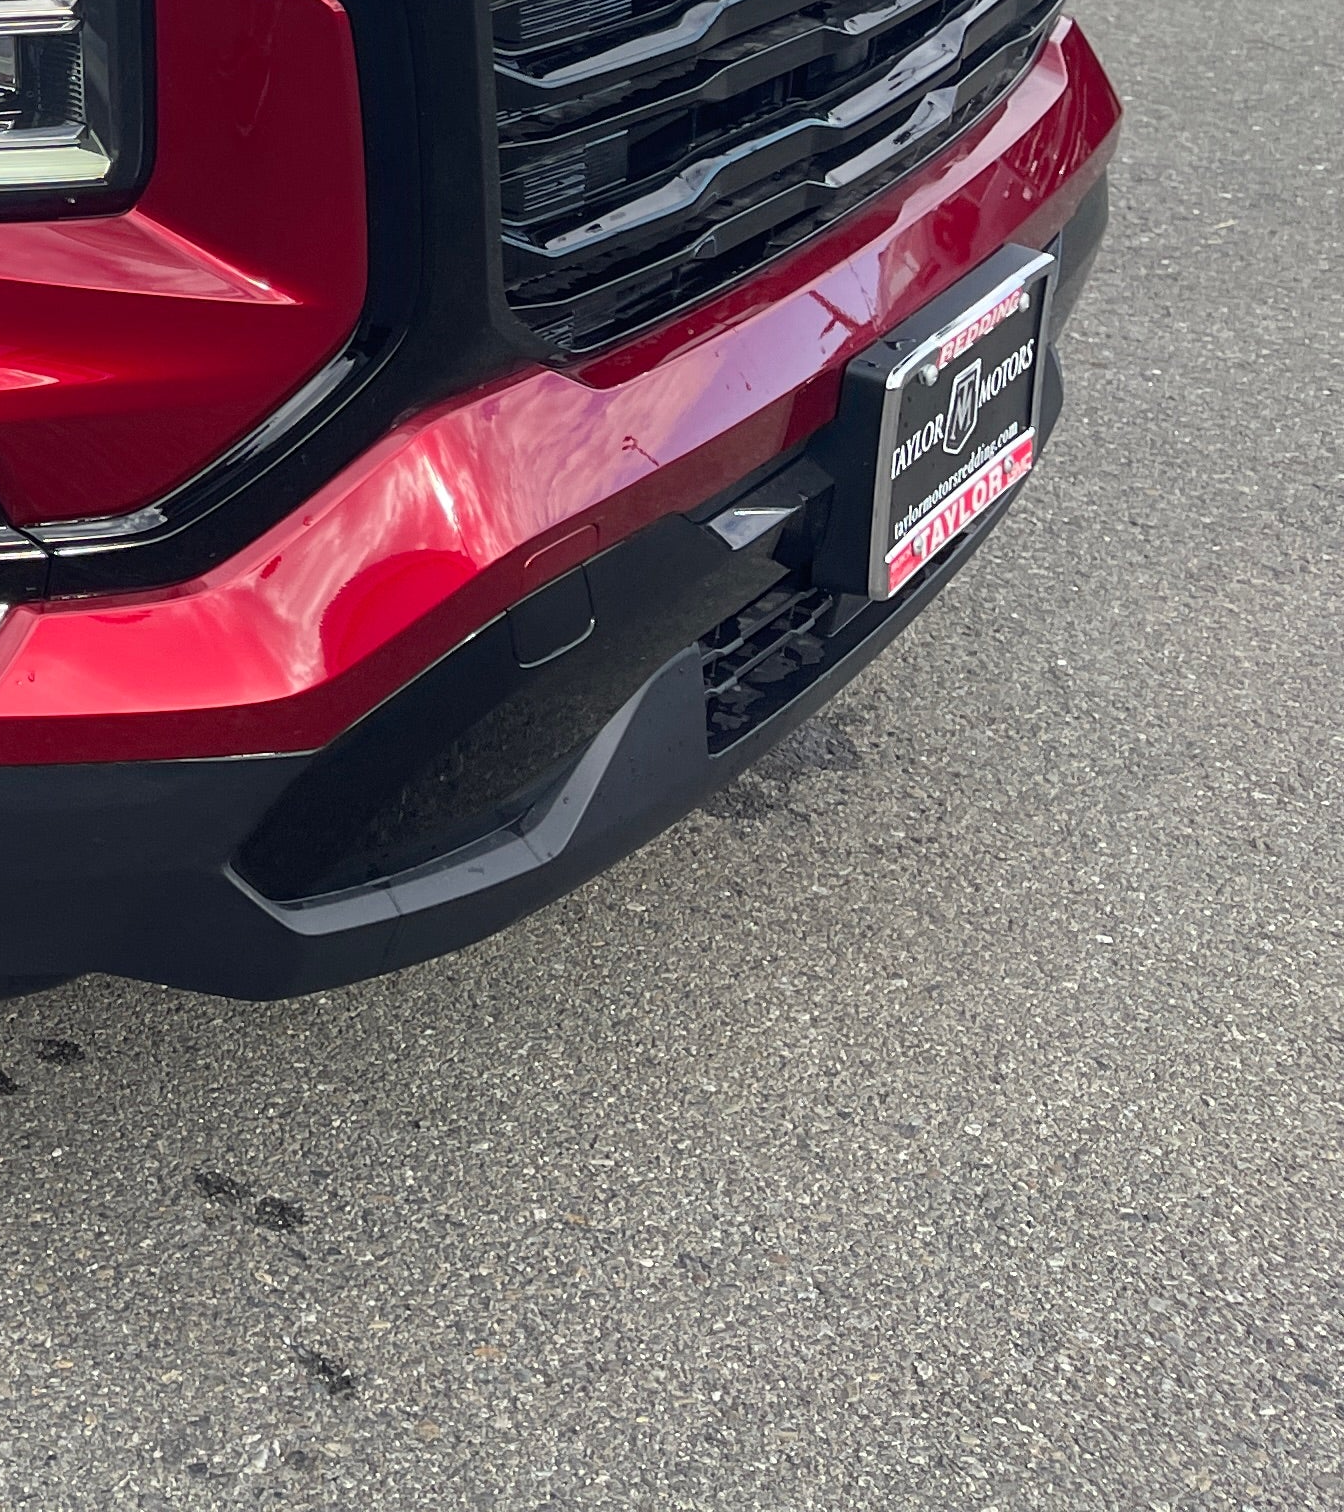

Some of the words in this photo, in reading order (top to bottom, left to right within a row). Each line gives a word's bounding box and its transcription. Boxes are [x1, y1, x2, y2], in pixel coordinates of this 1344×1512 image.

[937, 288, 1022, 368] REDDING
[890, 413, 944, 481] TAYLOR
[977, 338, 1035, 408] MOTORS
[894, 421, 1019, 540] taylormotorsredding.com
[919, 464, 1004, 561] TAYLOR
